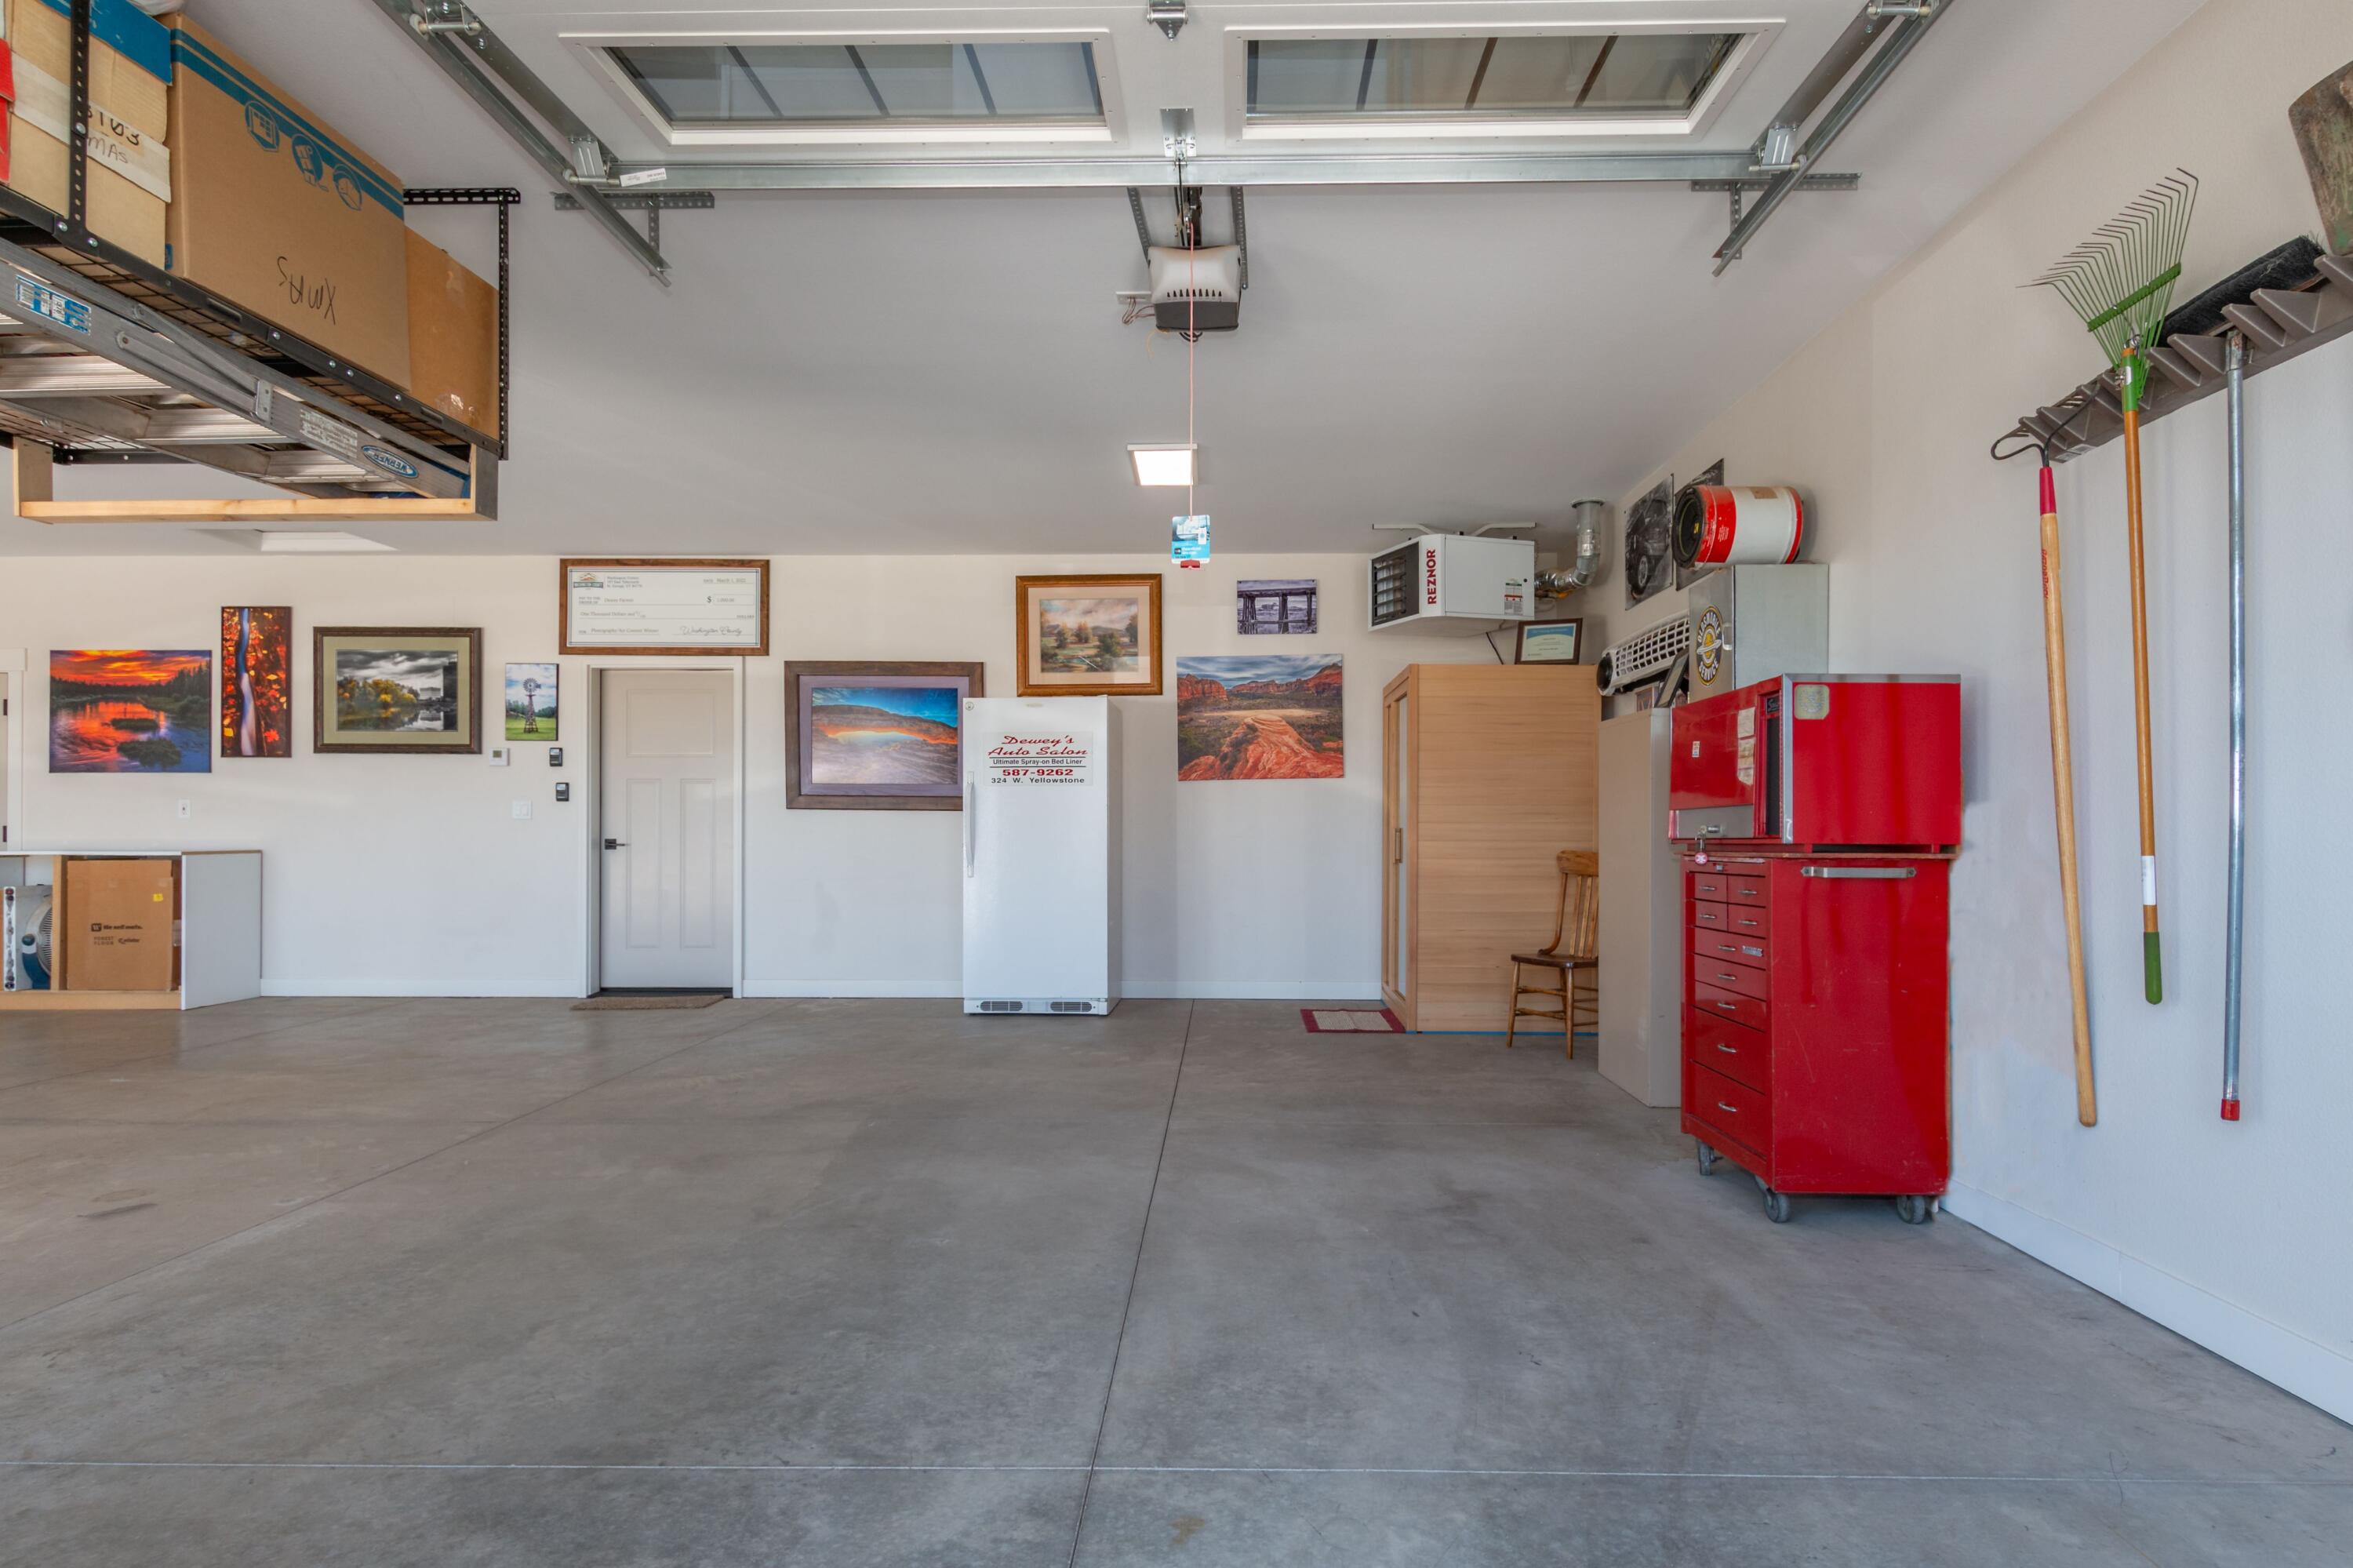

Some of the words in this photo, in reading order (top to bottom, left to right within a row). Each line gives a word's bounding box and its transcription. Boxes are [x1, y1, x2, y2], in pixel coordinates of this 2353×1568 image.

[1426, 548, 1437, 605] REZNOR
[1698, 657, 1718, 681] SERVICE
[988, 747, 1030, 755] Auto
[1036, 746, 1088, 755] Salon
[1002, 735, 1075, 748] Dewey's
